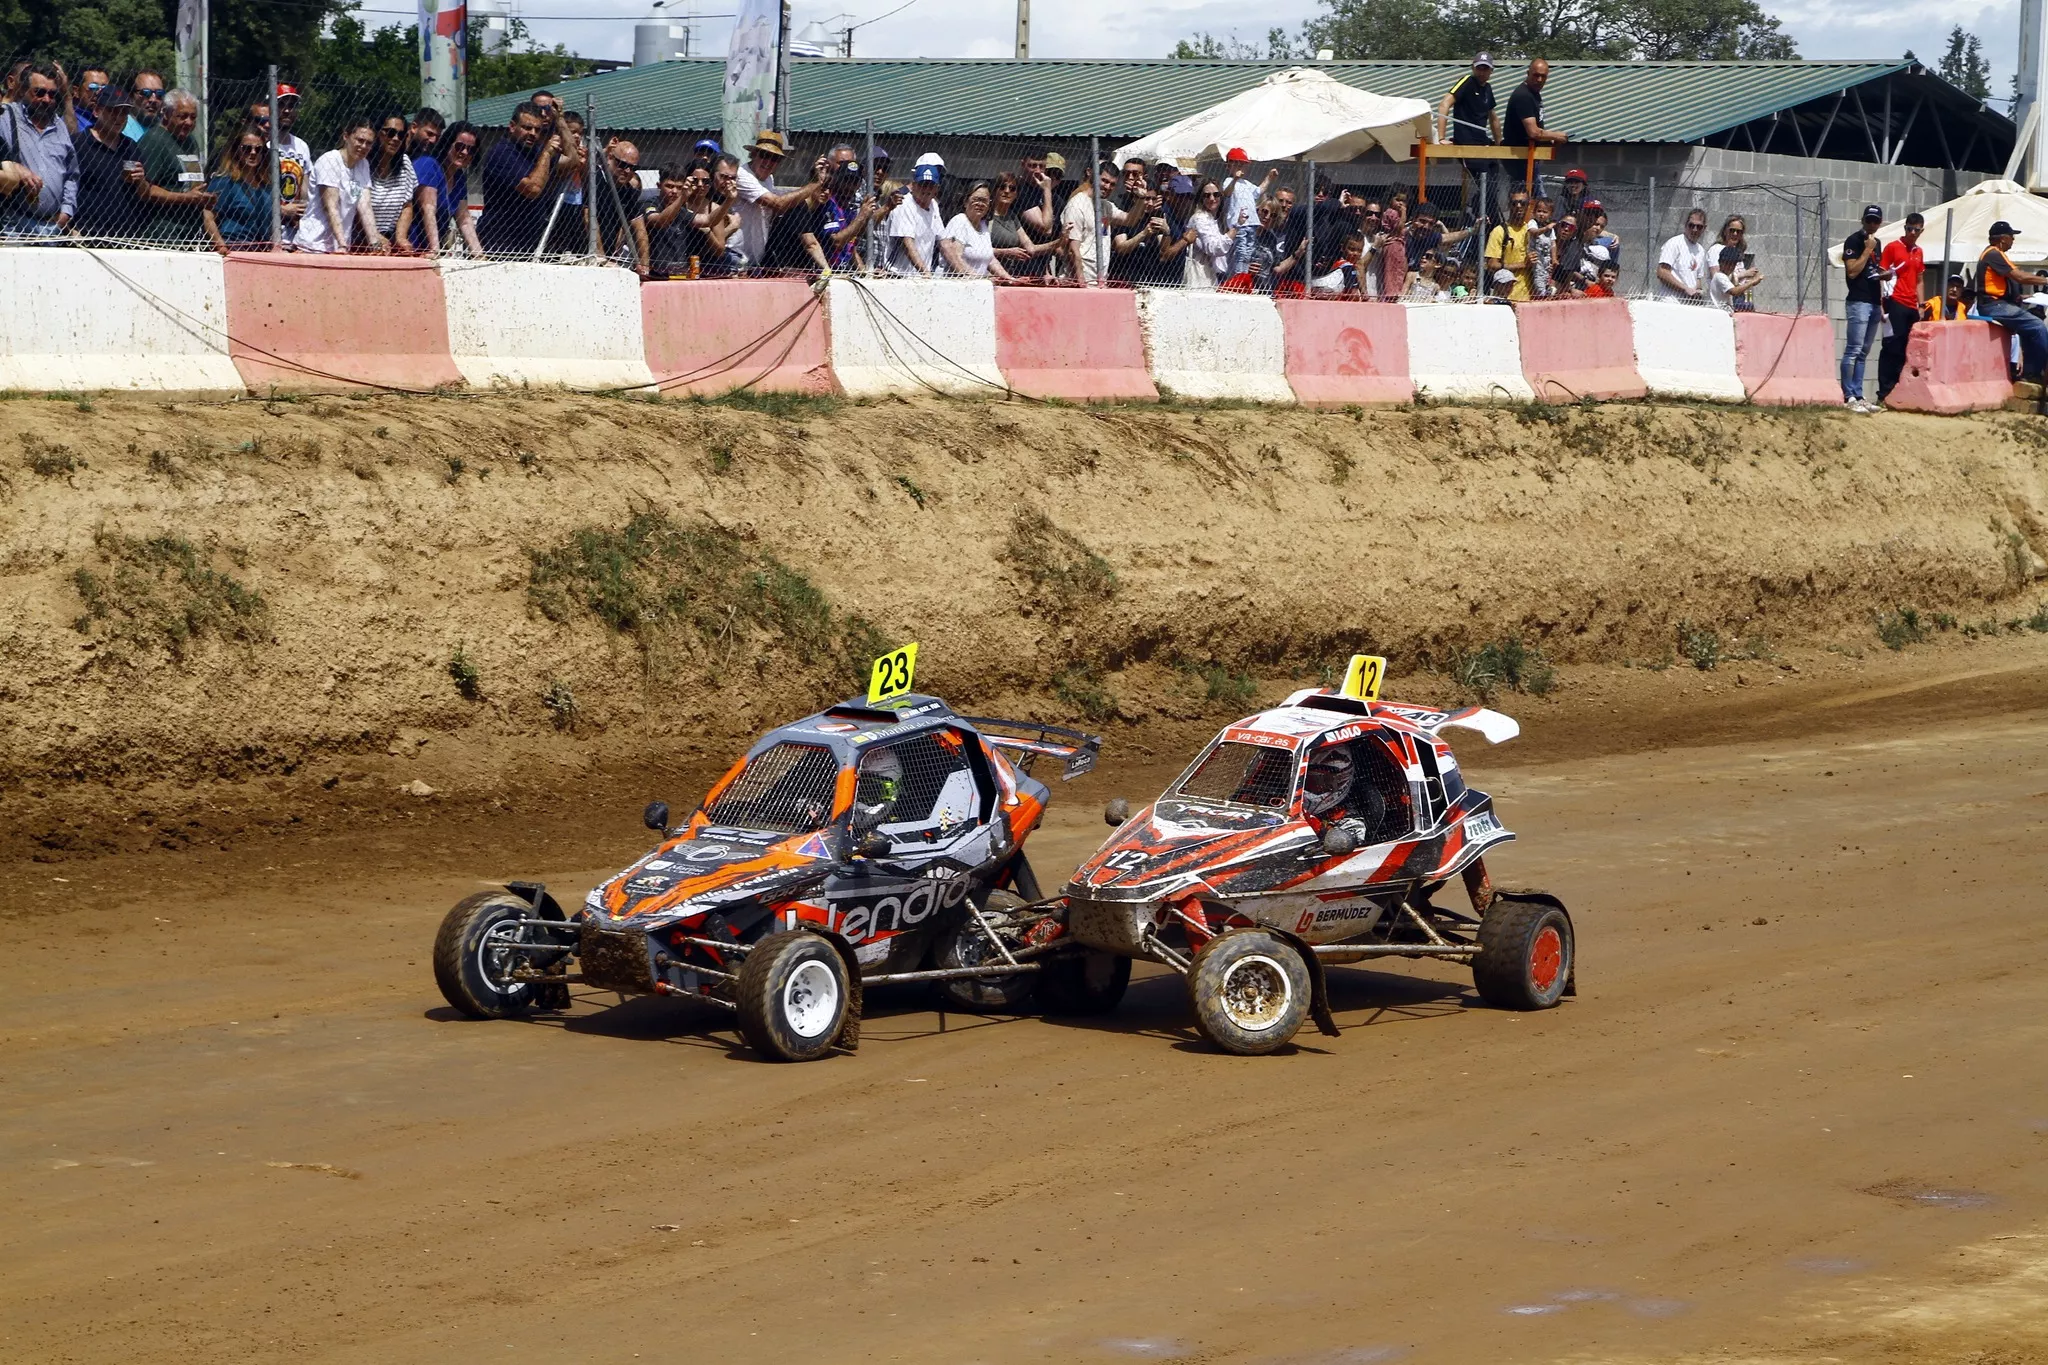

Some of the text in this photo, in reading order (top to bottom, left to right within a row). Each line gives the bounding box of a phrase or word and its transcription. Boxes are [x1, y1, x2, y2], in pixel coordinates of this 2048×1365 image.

[879, 652, 909, 696] 23
[1358, 660, 1377, 697] 12
[877, 723, 915, 738] Marina
[1335, 725, 1362, 742] LOLO
[1105, 850, 1149, 870] 12
[1315, 904, 1372, 922] BERMÚDEZ
